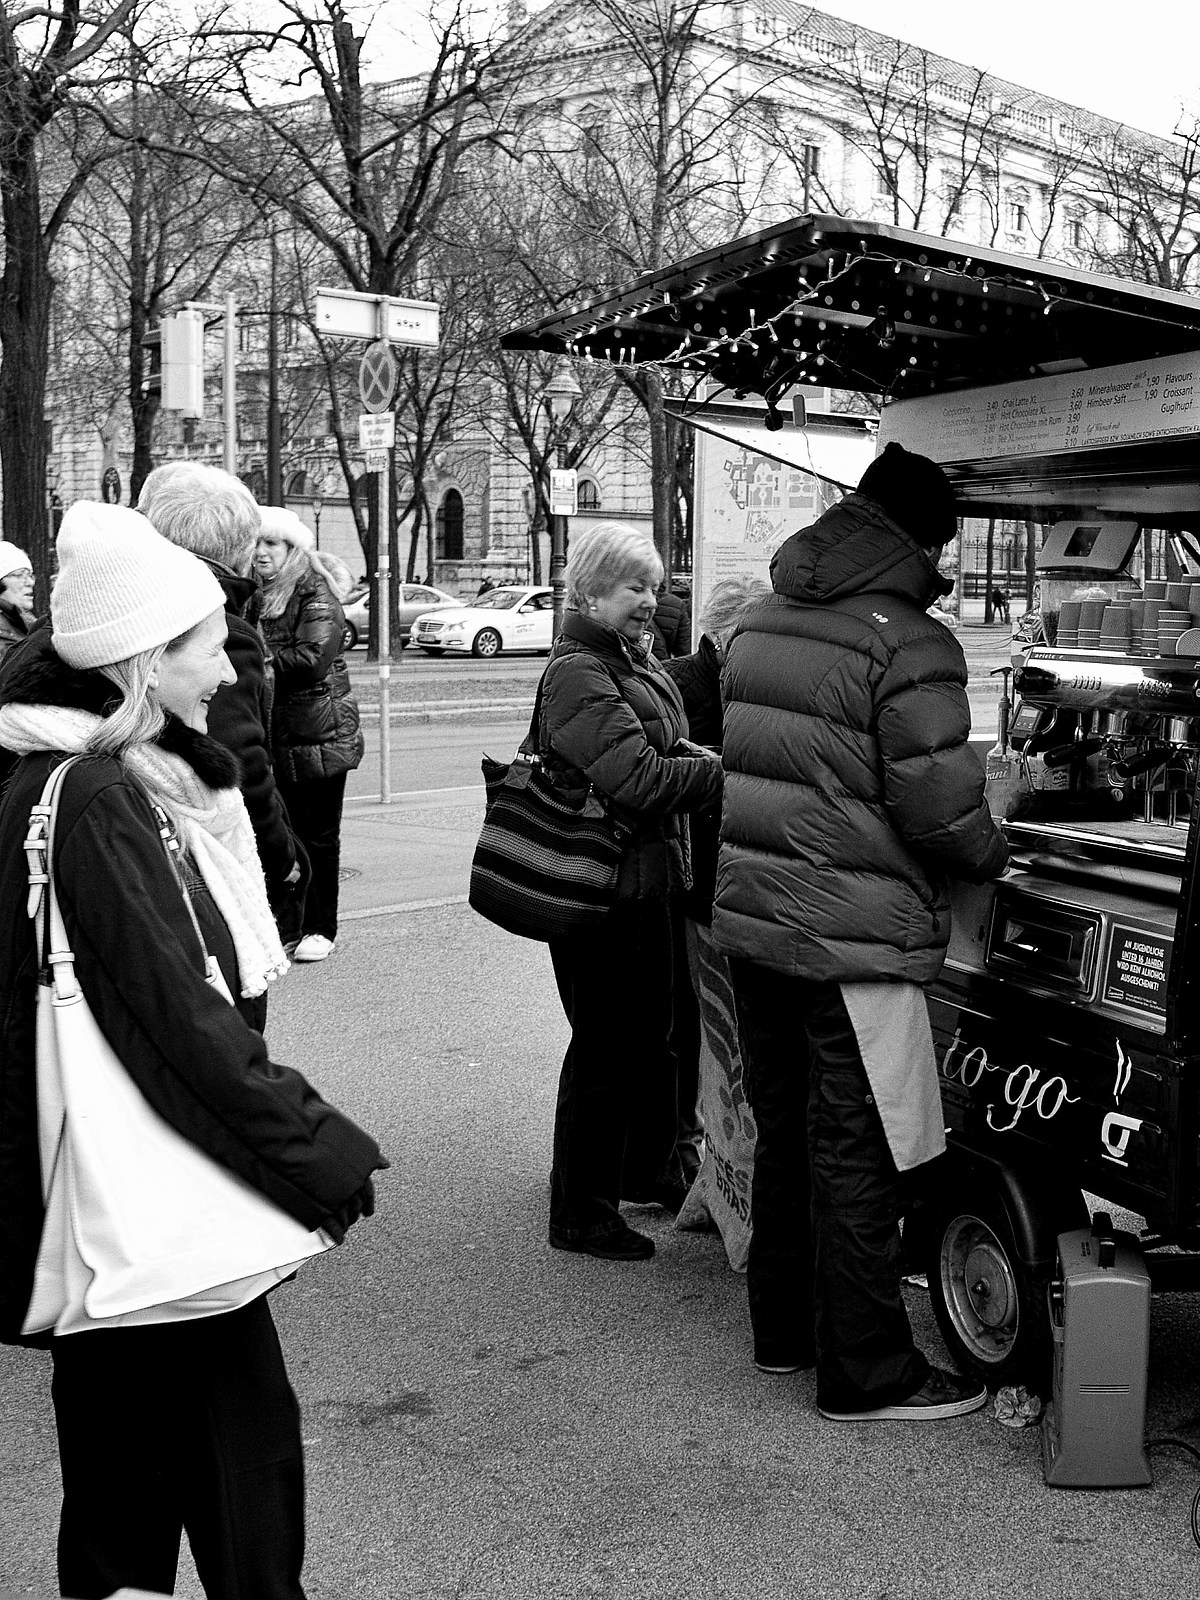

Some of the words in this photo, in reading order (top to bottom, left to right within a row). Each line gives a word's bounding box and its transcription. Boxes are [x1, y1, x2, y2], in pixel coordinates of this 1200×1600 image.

[1088, 380, 1133, 396] Mineralwasser
[1146, 375, 1160, 388] 1,90
[1165, 371, 1193, 384] Flavours
[1070, 387, 1085, 399] 3,60
[1086, 395, 1114, 409] Himbeer
[1114, 394, 1127, 405] Saft
[1144, 389, 1159, 401] 1,90
[1163, 385, 1194, 399] Croissant
[1000, 409, 1012, 420] Hot
[1011, 407, 1038, 418] Chocolate
[1068, 400, 1083, 412] 3,60
[1160, 398, 1194, 415] Guglhupf
[1067, 412, 1081, 424] 3,90
[1065, 425, 1079, 436] 2,40
[1064, 437, 1078, 448] 3,10
[1124, 940, 1132, 949] AN
[1132, 942, 1165, 957] JUGENDLICHE
[1121, 950, 1138, 962] UNTER
[1145, 957, 1164, 970] JAHREN
[1116, 960, 1130, 971] WIRD
[1130, 963, 1141, 975] KEIN
[1141, 966, 1166, 982] ALKOHOL
[1120, 974, 1160, 991] AUSGESCHENKT!
[942, 1028, 999, 1087] to
[986, 1064, 1081, 1132] go
